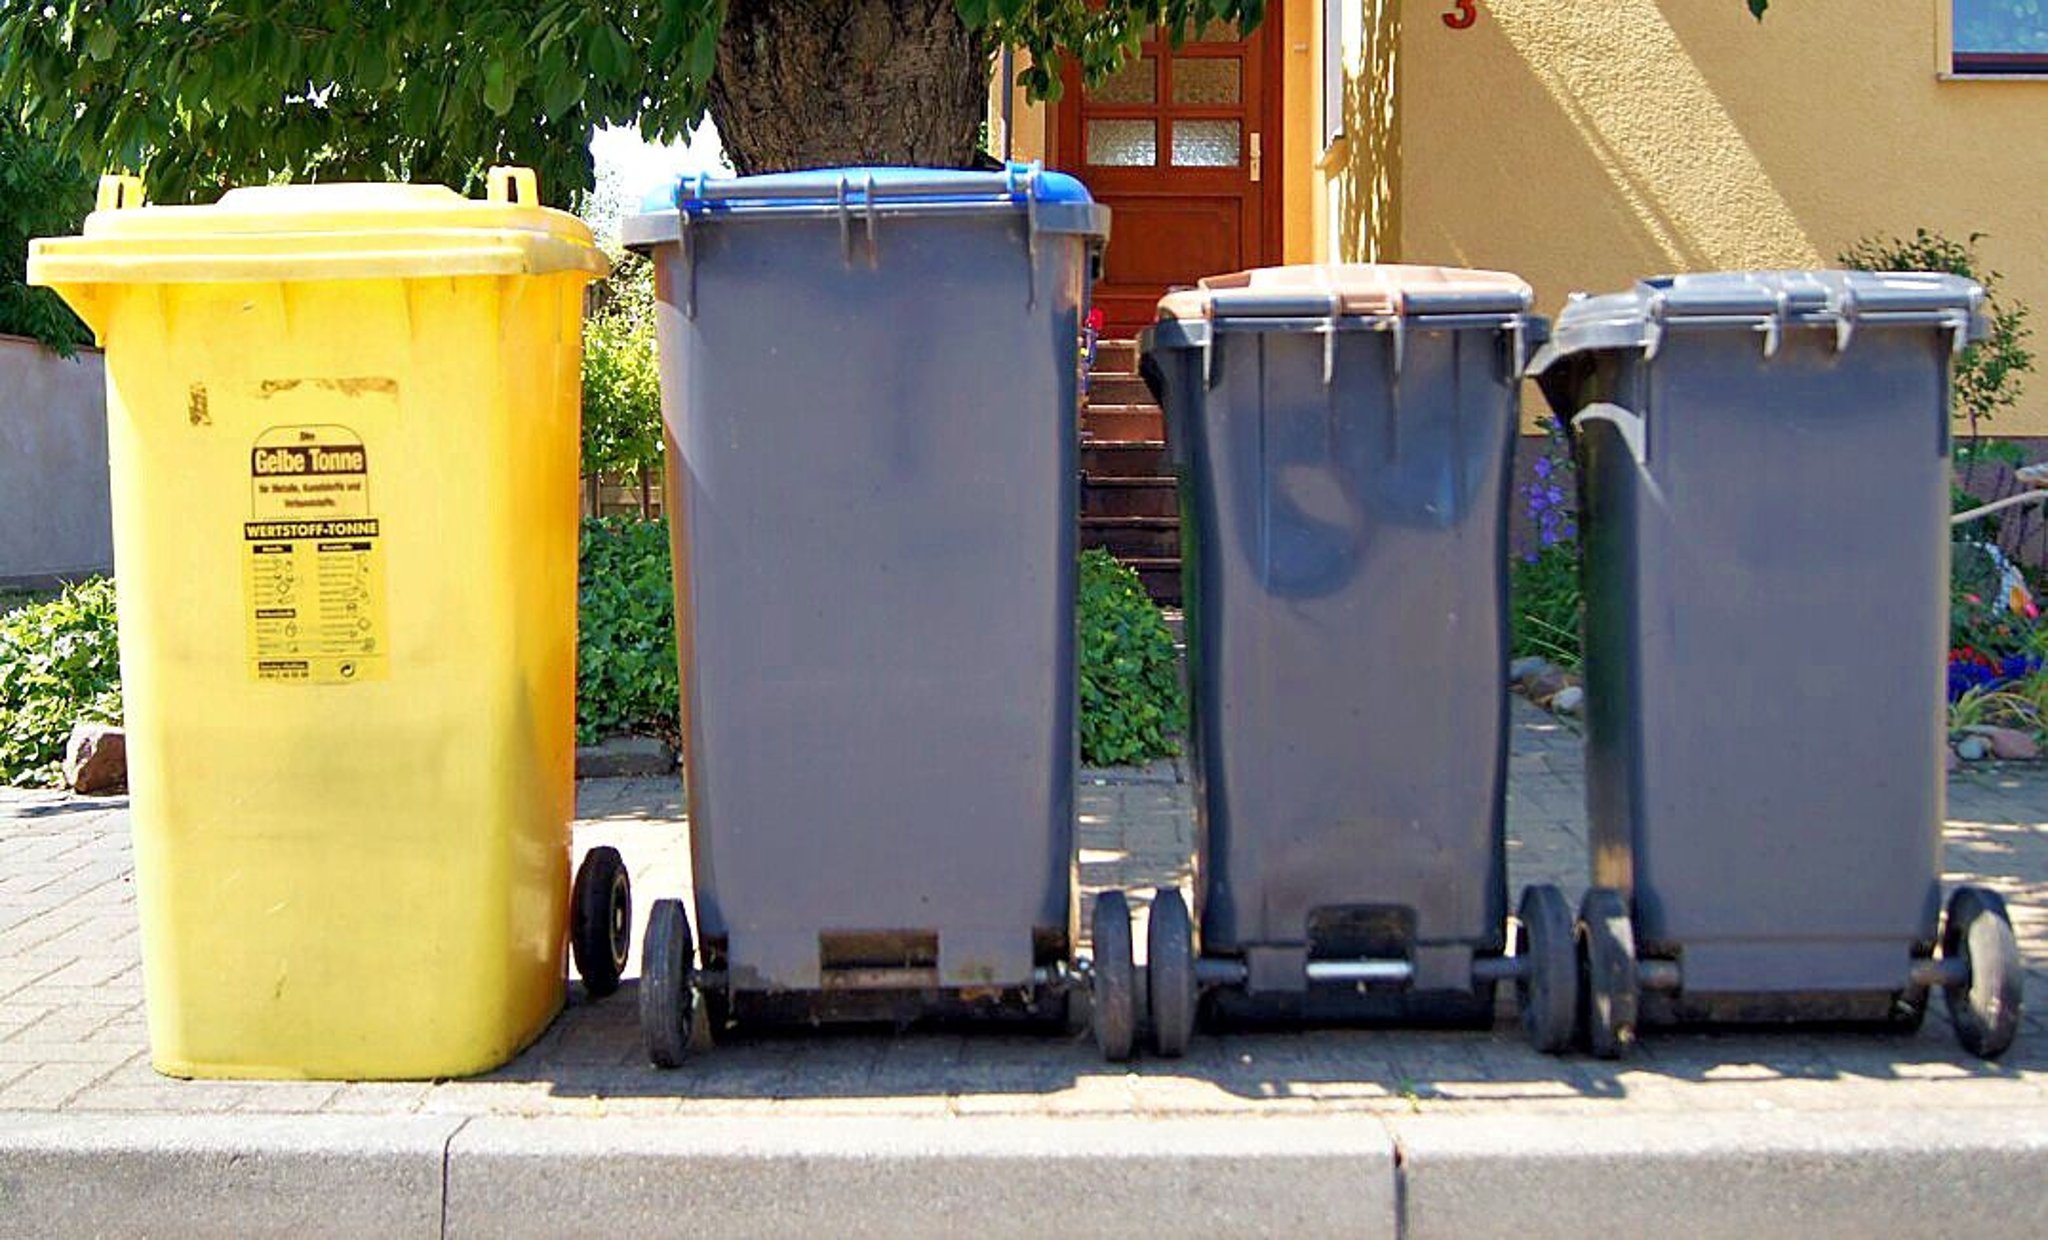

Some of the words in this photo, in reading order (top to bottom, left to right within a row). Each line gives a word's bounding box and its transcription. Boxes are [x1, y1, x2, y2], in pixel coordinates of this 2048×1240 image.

[255, 449, 305, 473] Gelbe
[308, 447, 363, 471] Tonne
[246, 522, 378, 538] WERTSTOFF-TONNE
